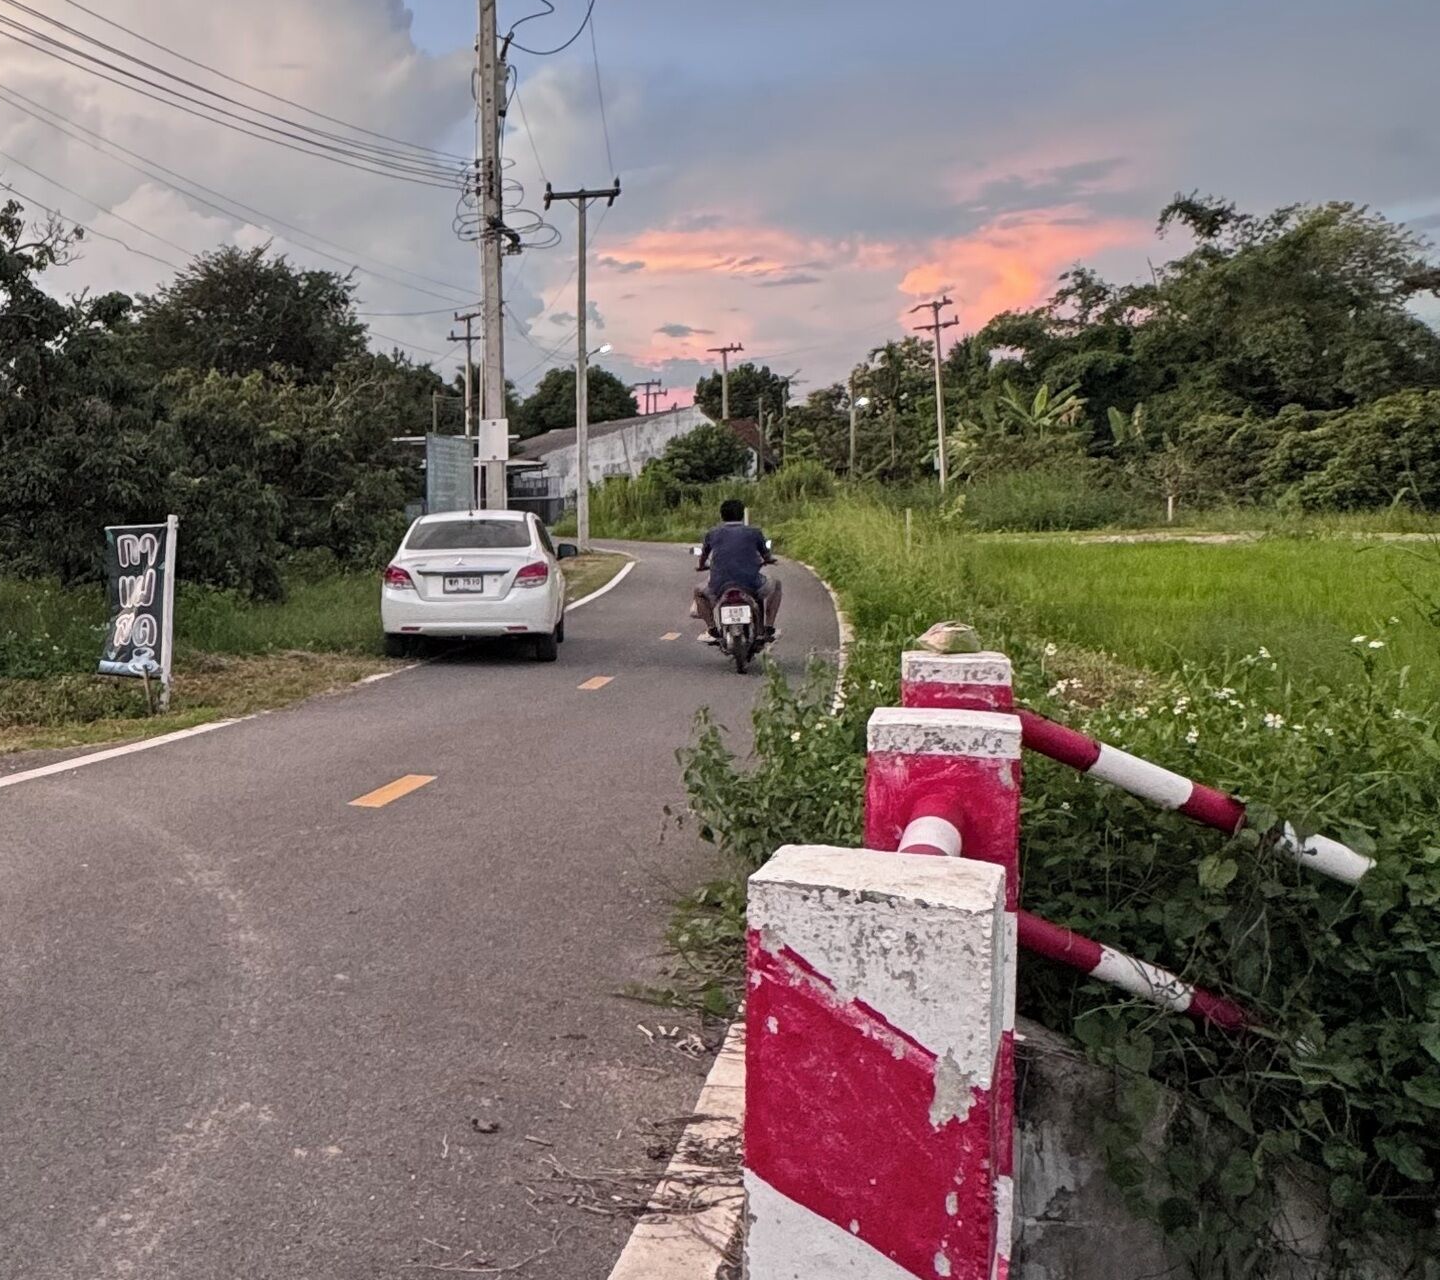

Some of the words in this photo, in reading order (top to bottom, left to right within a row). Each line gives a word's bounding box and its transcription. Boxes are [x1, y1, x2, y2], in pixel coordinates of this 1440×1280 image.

[117, 533, 158, 568] กา
[118, 568, 156, 608] แฟ
[113, 613, 157, 647] สด
